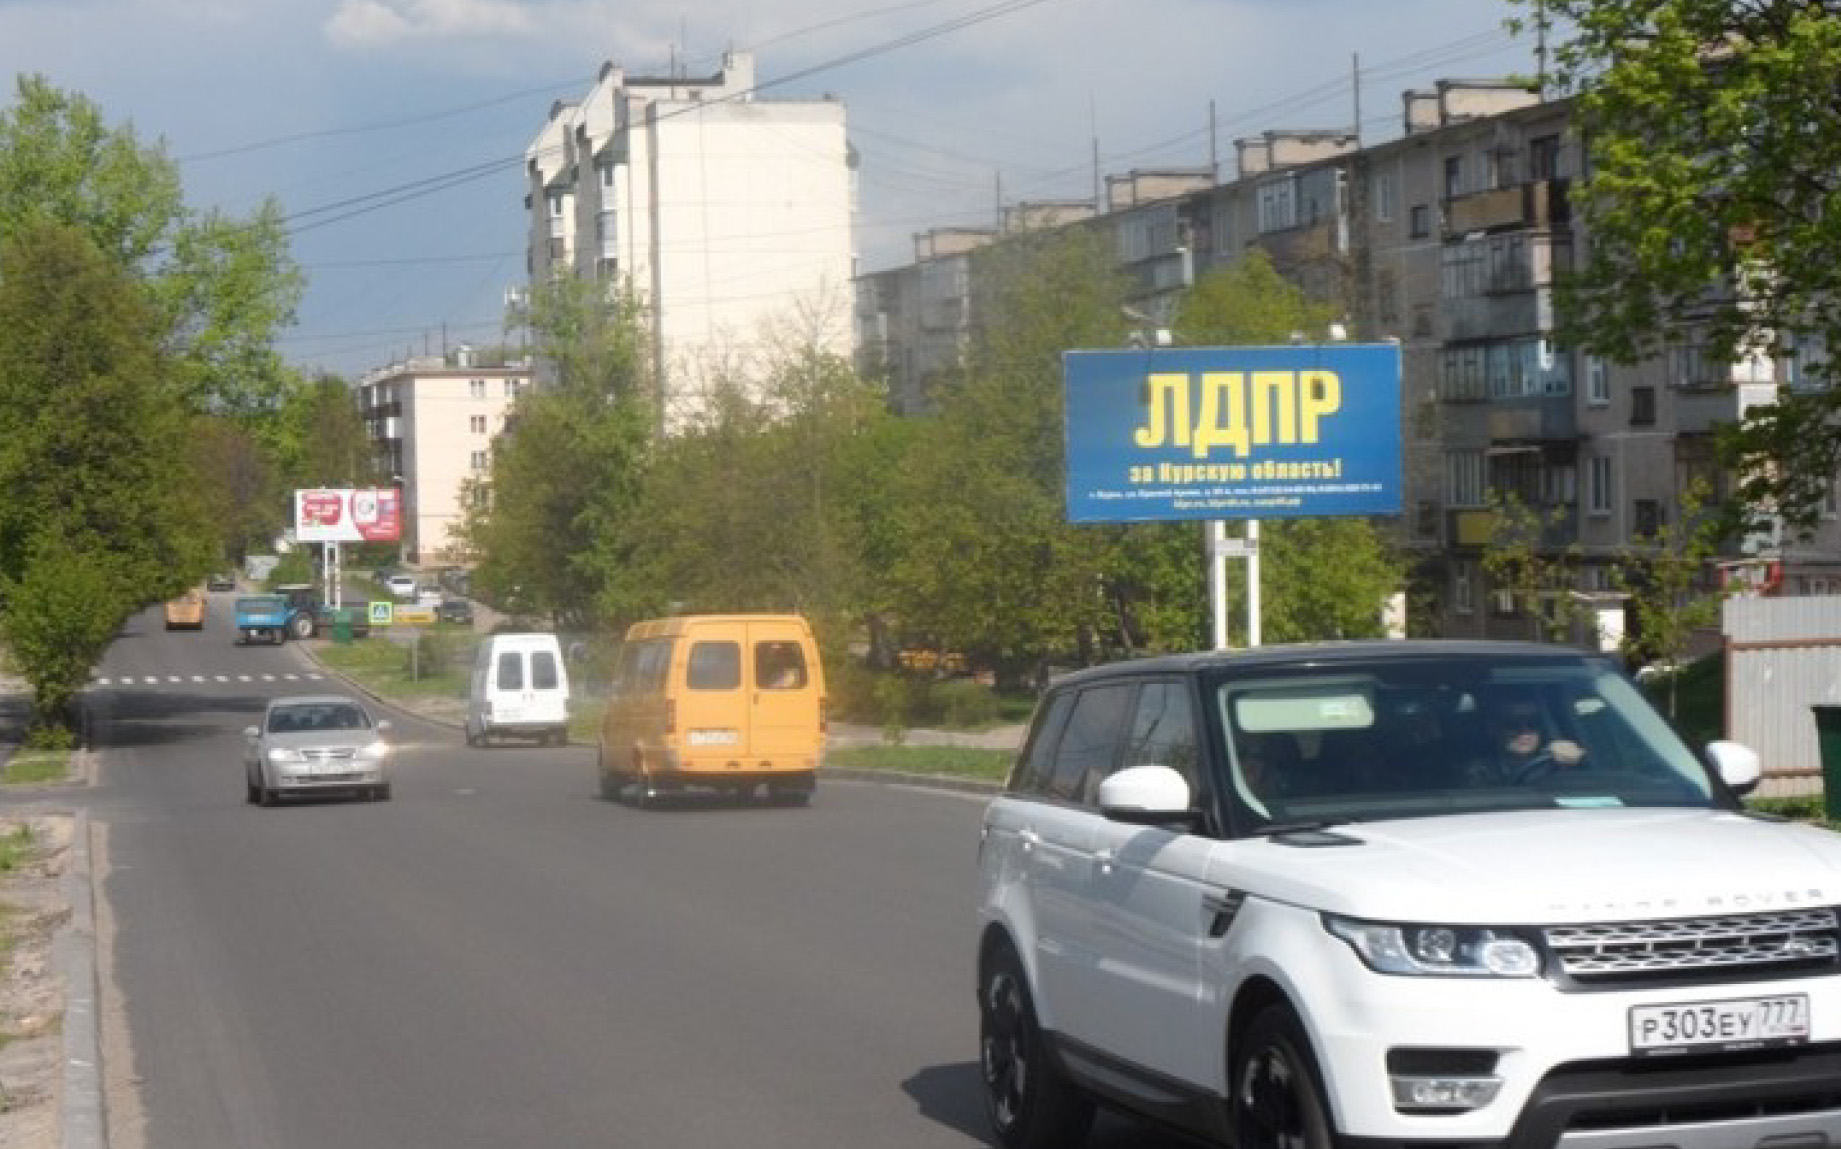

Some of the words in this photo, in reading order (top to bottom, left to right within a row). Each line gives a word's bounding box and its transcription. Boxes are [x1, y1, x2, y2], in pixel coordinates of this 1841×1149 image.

[1134, 370, 1342, 458] ЛДПР
[1128, 465, 1154, 483] за
[1158, 462, 1246, 484] Курскую
[1252, 457, 1342, 481] область!
